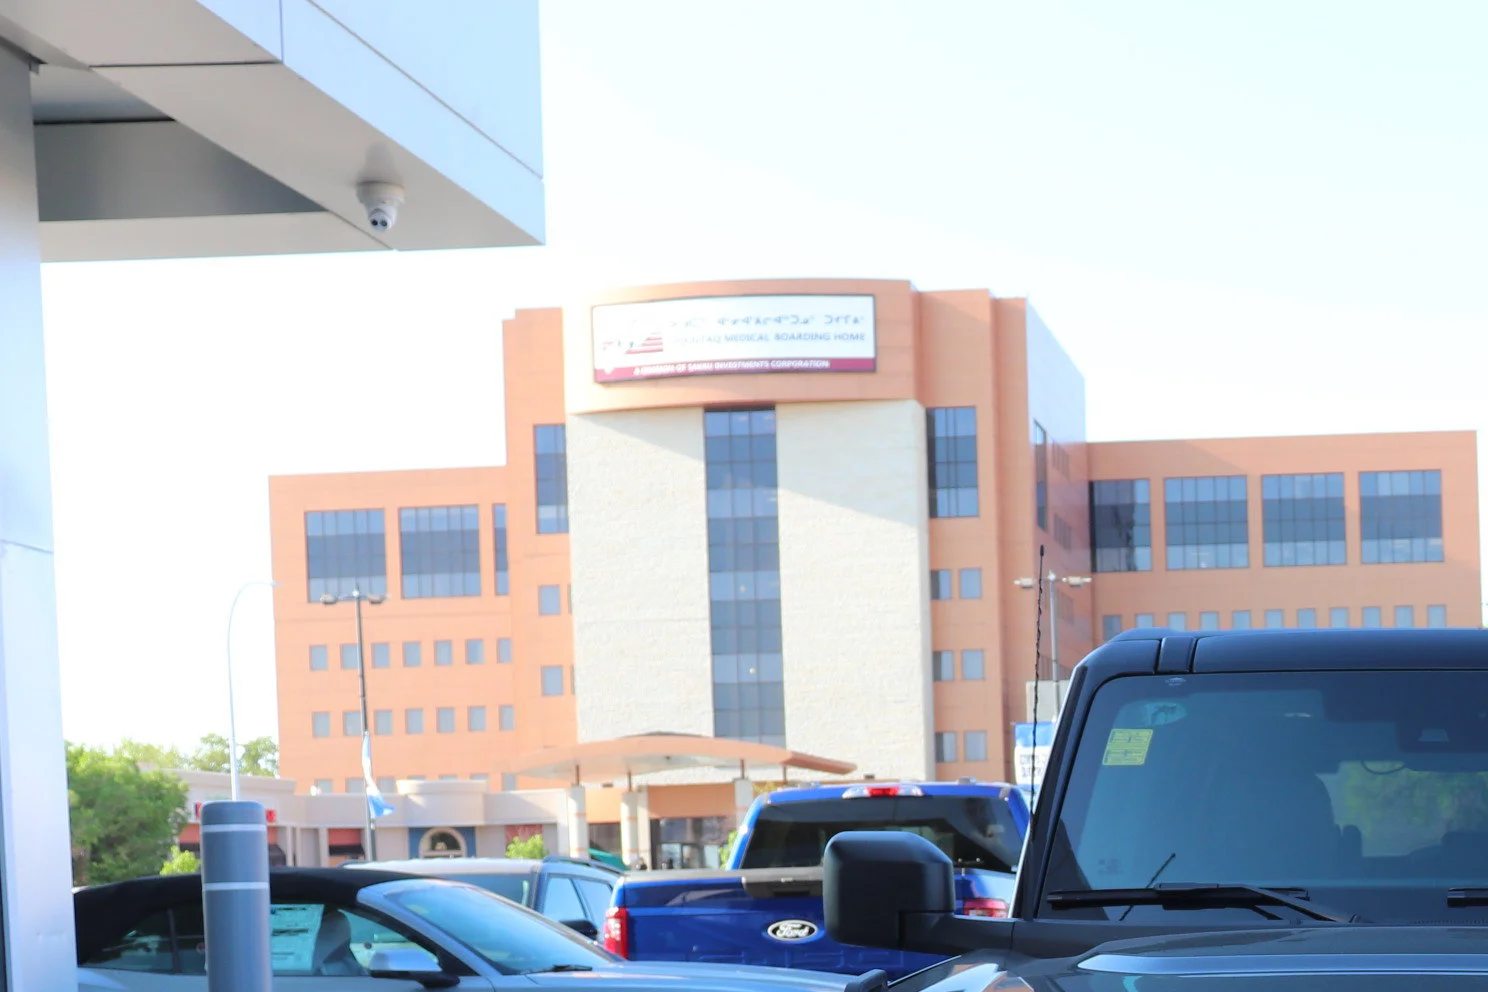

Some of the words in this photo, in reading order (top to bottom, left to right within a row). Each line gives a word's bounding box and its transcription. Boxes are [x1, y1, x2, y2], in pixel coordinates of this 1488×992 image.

[724, 332, 769, 342] MEDICAL
[774, 332, 830, 341] BOARDING
[834, 332, 865, 341] HOME
[770, 359, 830, 369] CORPORATION
